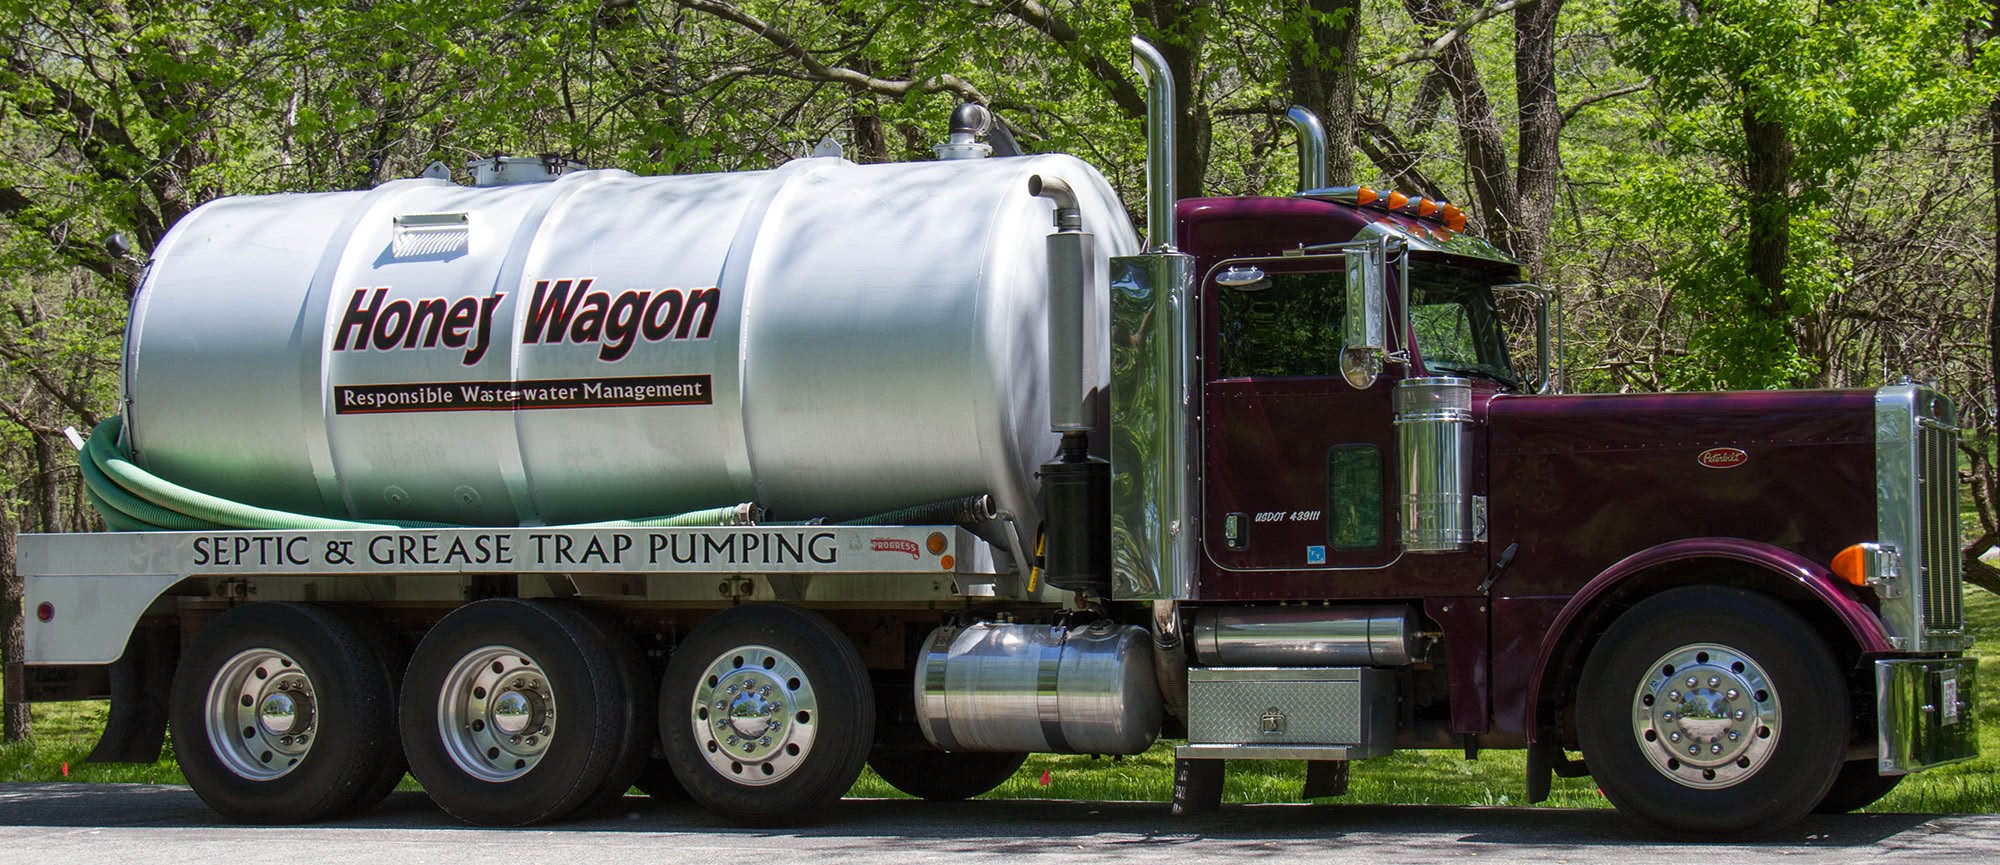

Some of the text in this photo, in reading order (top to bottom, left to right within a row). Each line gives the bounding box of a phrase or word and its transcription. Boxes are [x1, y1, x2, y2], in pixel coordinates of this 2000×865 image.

[332, 277, 721, 367] Honey Wagon
[343, 386, 454, 407] Responsible
[583, 380, 703, 402] Management
[1703, 452, 1742, 463] Peterbilt
[1255, 512, 1286, 522] USDOT
[193, 532, 838, 566] SEPTIC & GREASE TRAP PUMPING
[872, 541, 917, 553] PROGRESS
